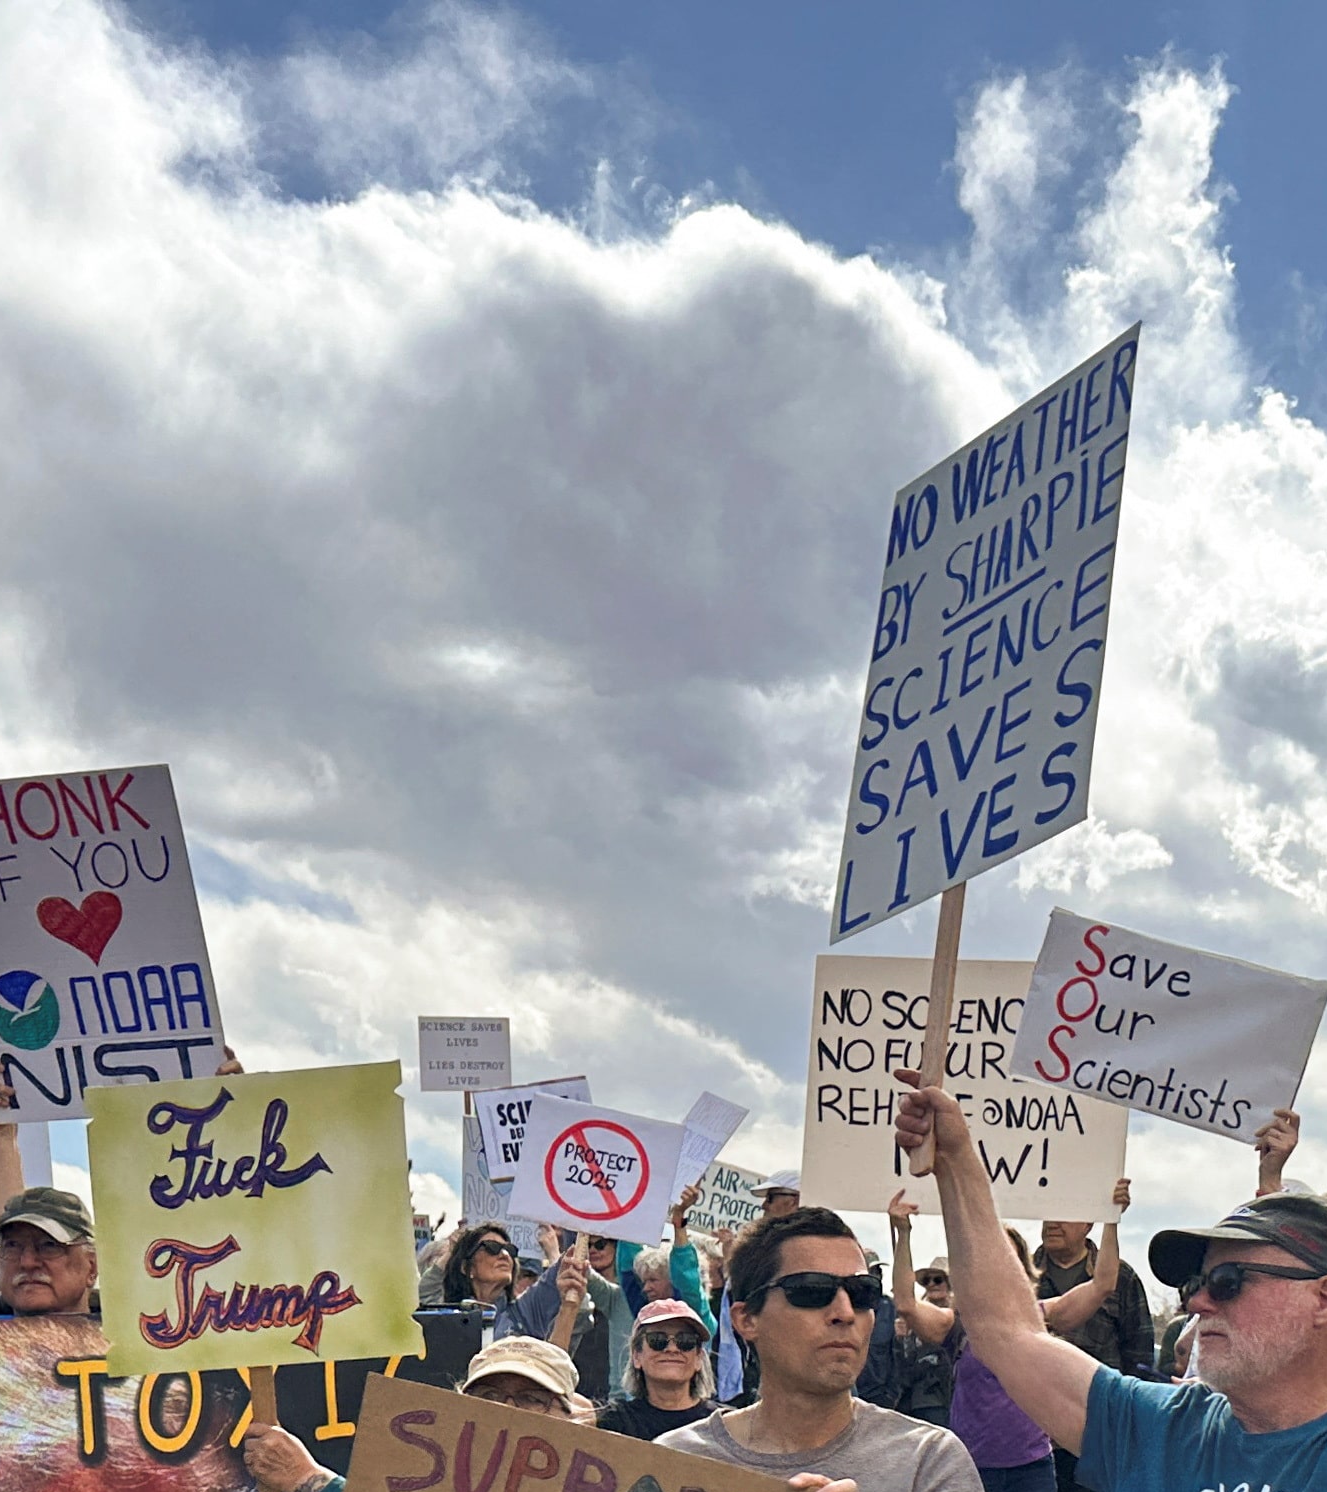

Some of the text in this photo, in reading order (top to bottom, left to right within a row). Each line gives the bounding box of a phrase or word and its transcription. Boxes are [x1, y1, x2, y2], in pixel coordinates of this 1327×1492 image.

[886, 340, 1138, 567] NO WEATHER
[873, 431, 1129, 664] BY SHARPIE
[862, 541, 1116, 751] SCIENCE
[856, 638, 1103, 836] SAVES
[50, 835, 170, 893] YOU
[839, 742, 1078, 935] LIVES
[1075, 924, 1192, 998] Save
[420, 1022, 503, 1032] SCIENCE SAVES
[821, 988, 1025, 1035] NO SCENC
[1056, 976, 1156, 1041] Our
[428, 1061, 505, 1070] LIES DESTROY
[446, 1038, 479, 1047] LIVES
[818, 1037, 1028, 1082] NO FUUR
[0, 1037, 214, 1110] NIST
[447, 1076, 480, 1085] LIVES
[1034, 1025, 1252, 1132] Scientists
[818, 1084, 973, 1129] REH
[147, 1086, 334, 1210] Fuck
[564, 1142, 638, 1174] PROJECT
[565, 1164, 619, 1191] 2025
[709, 1193, 762, 1221] PROTEC
[712, 1167, 740, 1193] AIR
[139, 1234, 363, 1357] Trump
[55, 1337, 426, 1457] TOI
